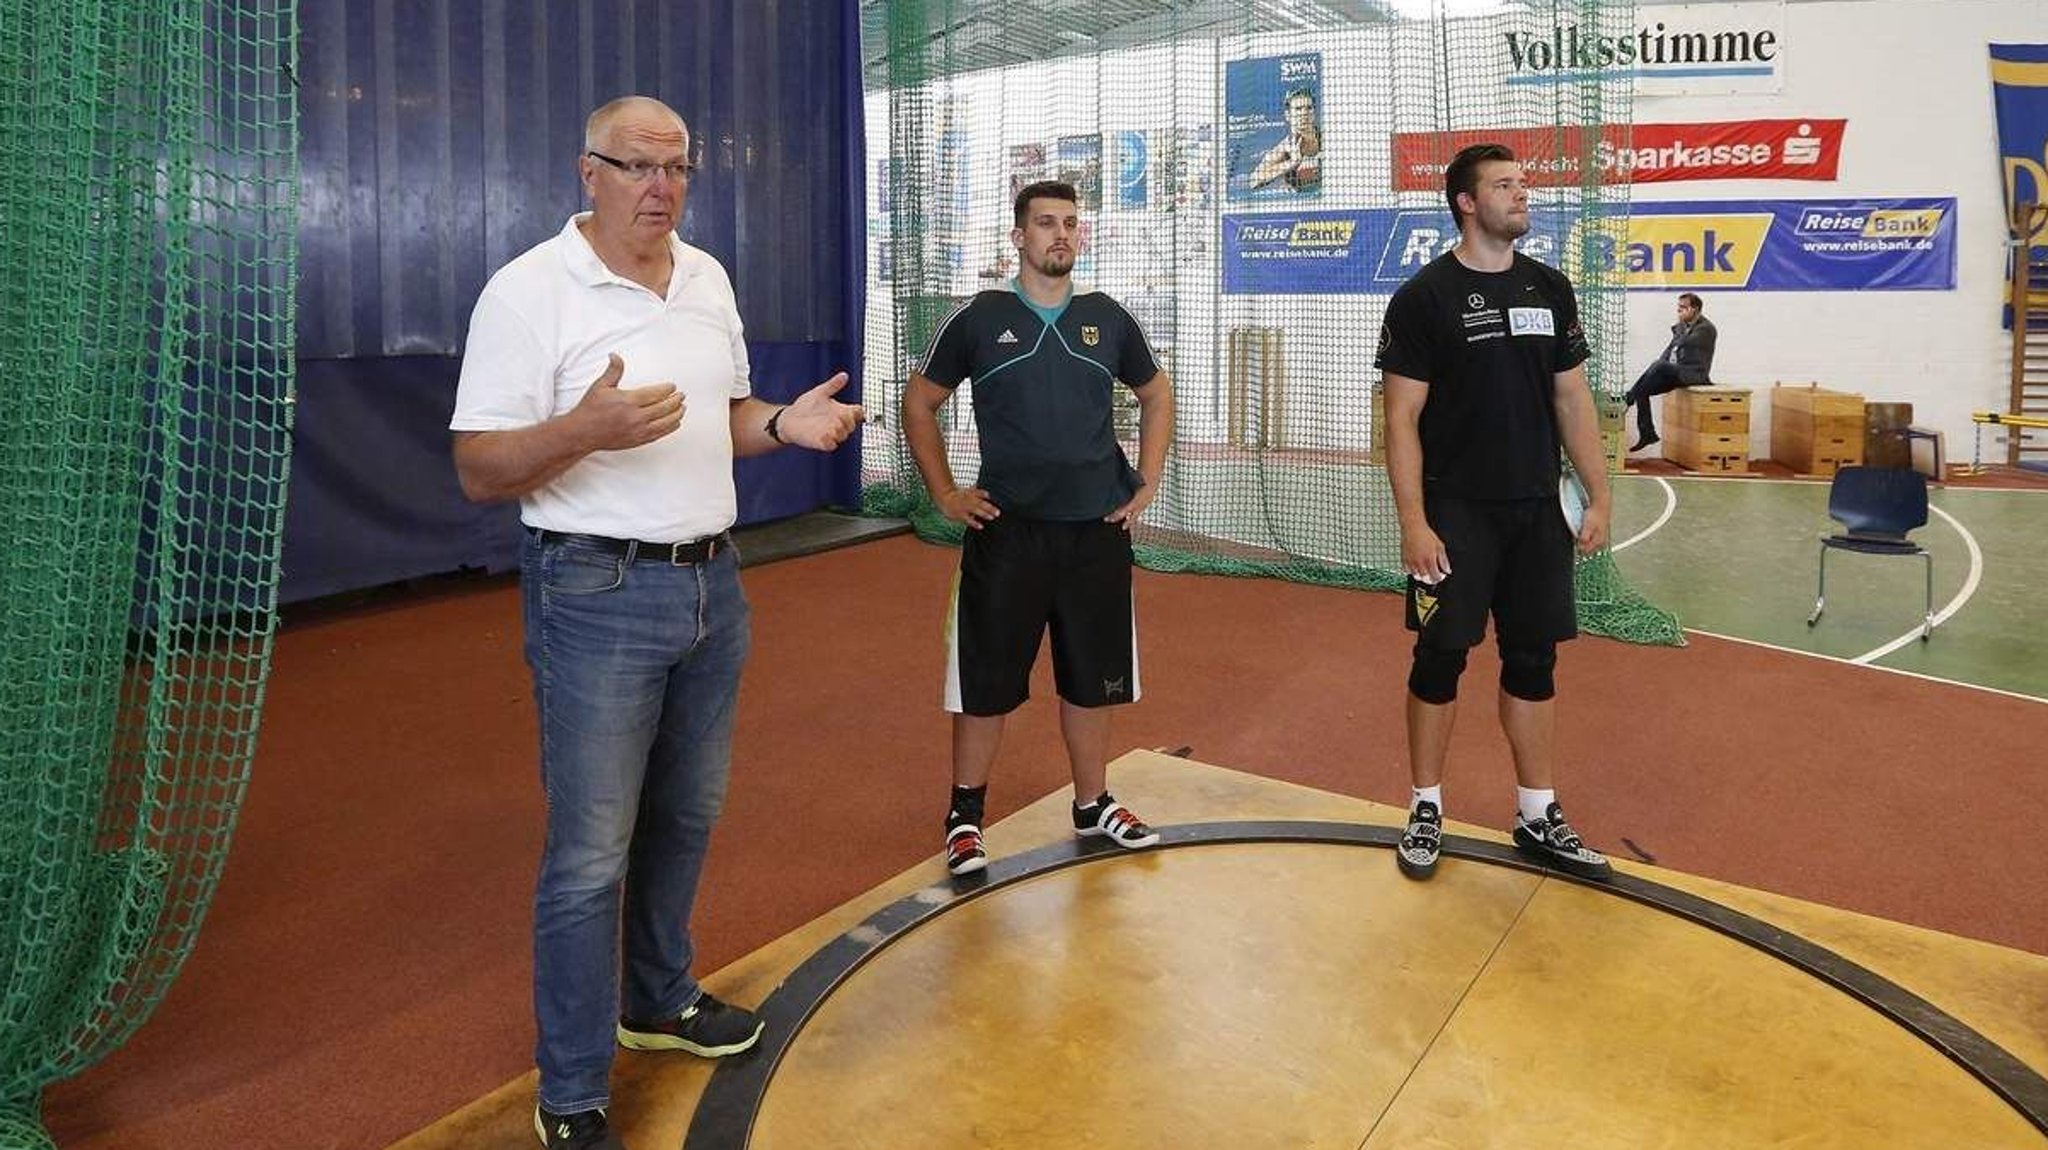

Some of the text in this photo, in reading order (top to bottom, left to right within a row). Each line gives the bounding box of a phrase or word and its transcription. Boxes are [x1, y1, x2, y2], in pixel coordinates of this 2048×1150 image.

[1504, 22, 1776, 72] Volksstimme
[1593, 139, 1771, 177] Sparkasse
[1804, 213, 1929, 232] Reise Bank
[1584, 229, 1734, 273] Bank
[1804, 239, 1934, 251] www.reisebank.de
[1512, 312, 1552, 330] DKB
